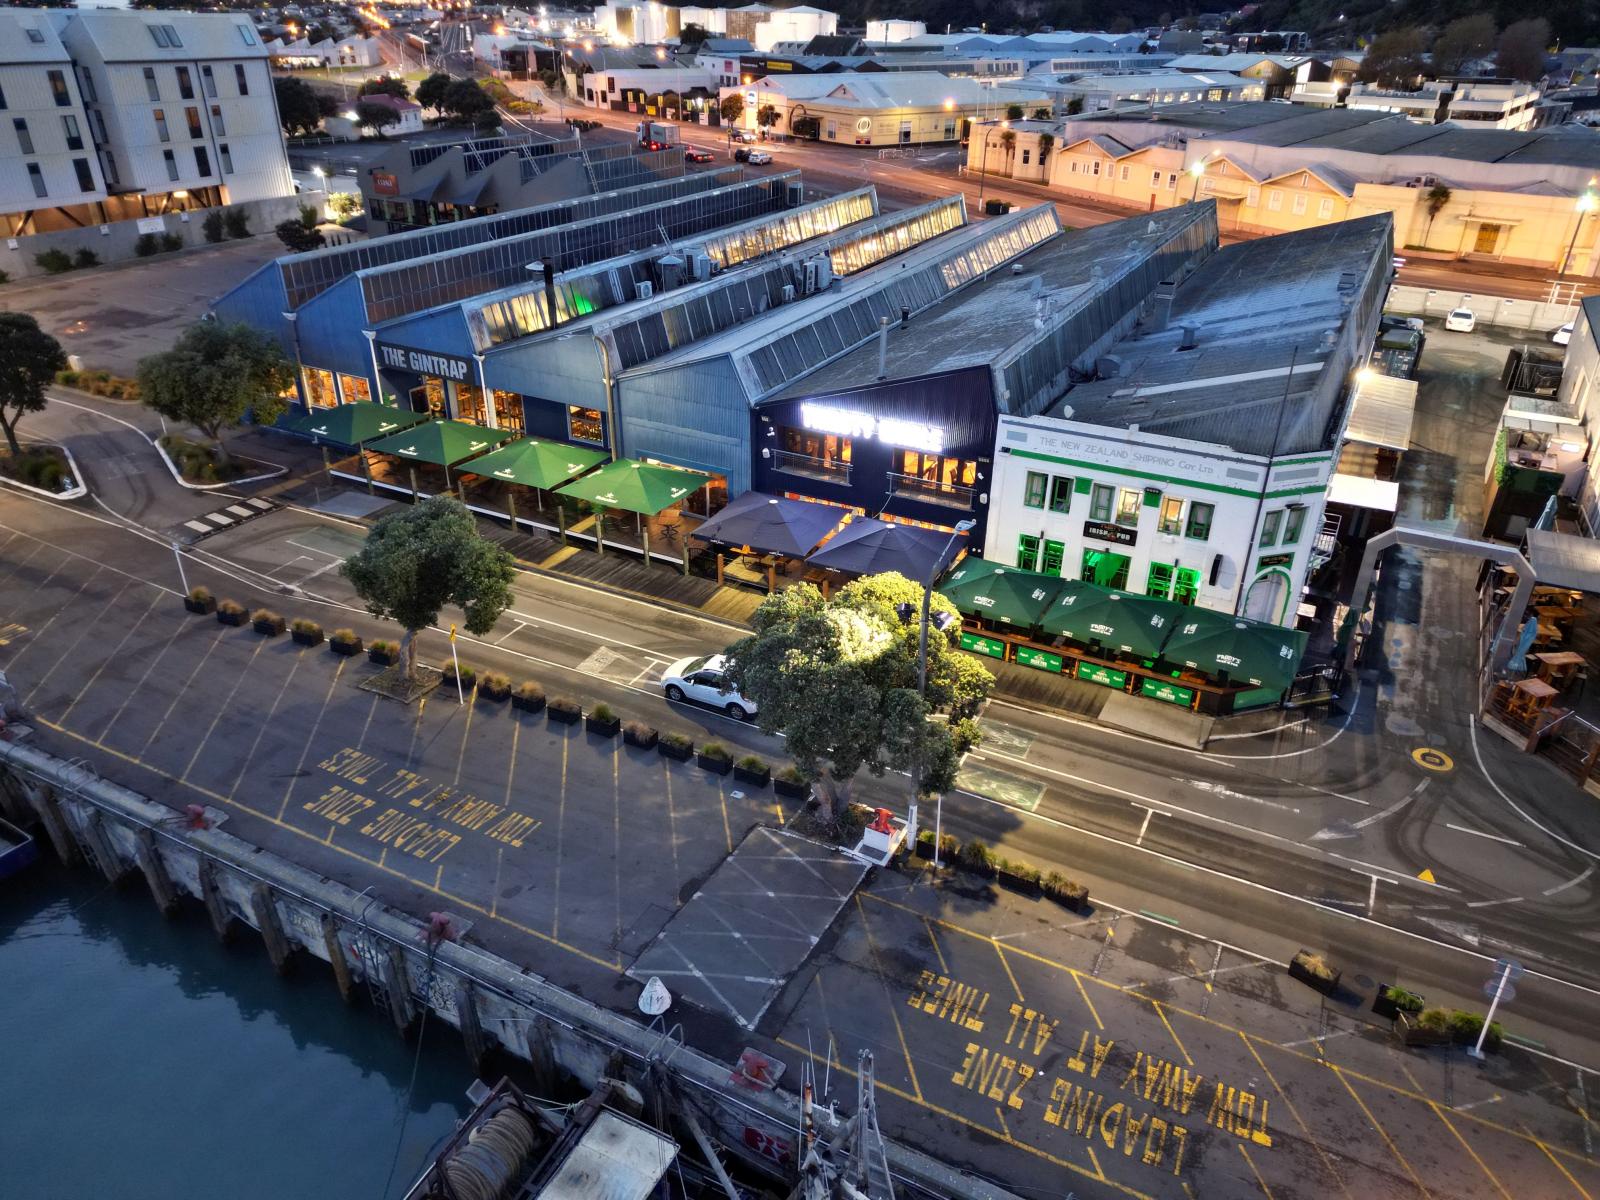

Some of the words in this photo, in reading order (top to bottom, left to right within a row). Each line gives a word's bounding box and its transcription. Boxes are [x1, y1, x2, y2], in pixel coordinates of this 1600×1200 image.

[381, 346, 407, 368] THE
[409, 352, 467, 379] GINTRAP
[1040, 436, 1057, 447] THE
[1061, 440, 1080, 451] NEW
[1084, 444, 1128, 458] ZEALAND
[1132, 452, 1175, 467] SHIPPING
[1116, 532, 1131, 540] PUB
[317, 748, 386, 784] TIMES
[377, 769, 429, 798] ALL
[302, 785, 376, 825] ZONE
[437, 794, 506, 830] AWAY
[360, 809, 462, 862] LOADING
[484, 812, 542, 847] TOW
[1004, 1003, 1060, 1056] ALL
[1067, 1030, 1114, 1079] AT
[952, 1042, 1035, 1110] ZONE
[1120, 1051, 1202, 1115] AWAY
[1043, 1077, 1187, 1176] LOADING
[1207, 1081, 1272, 1147] TOW
